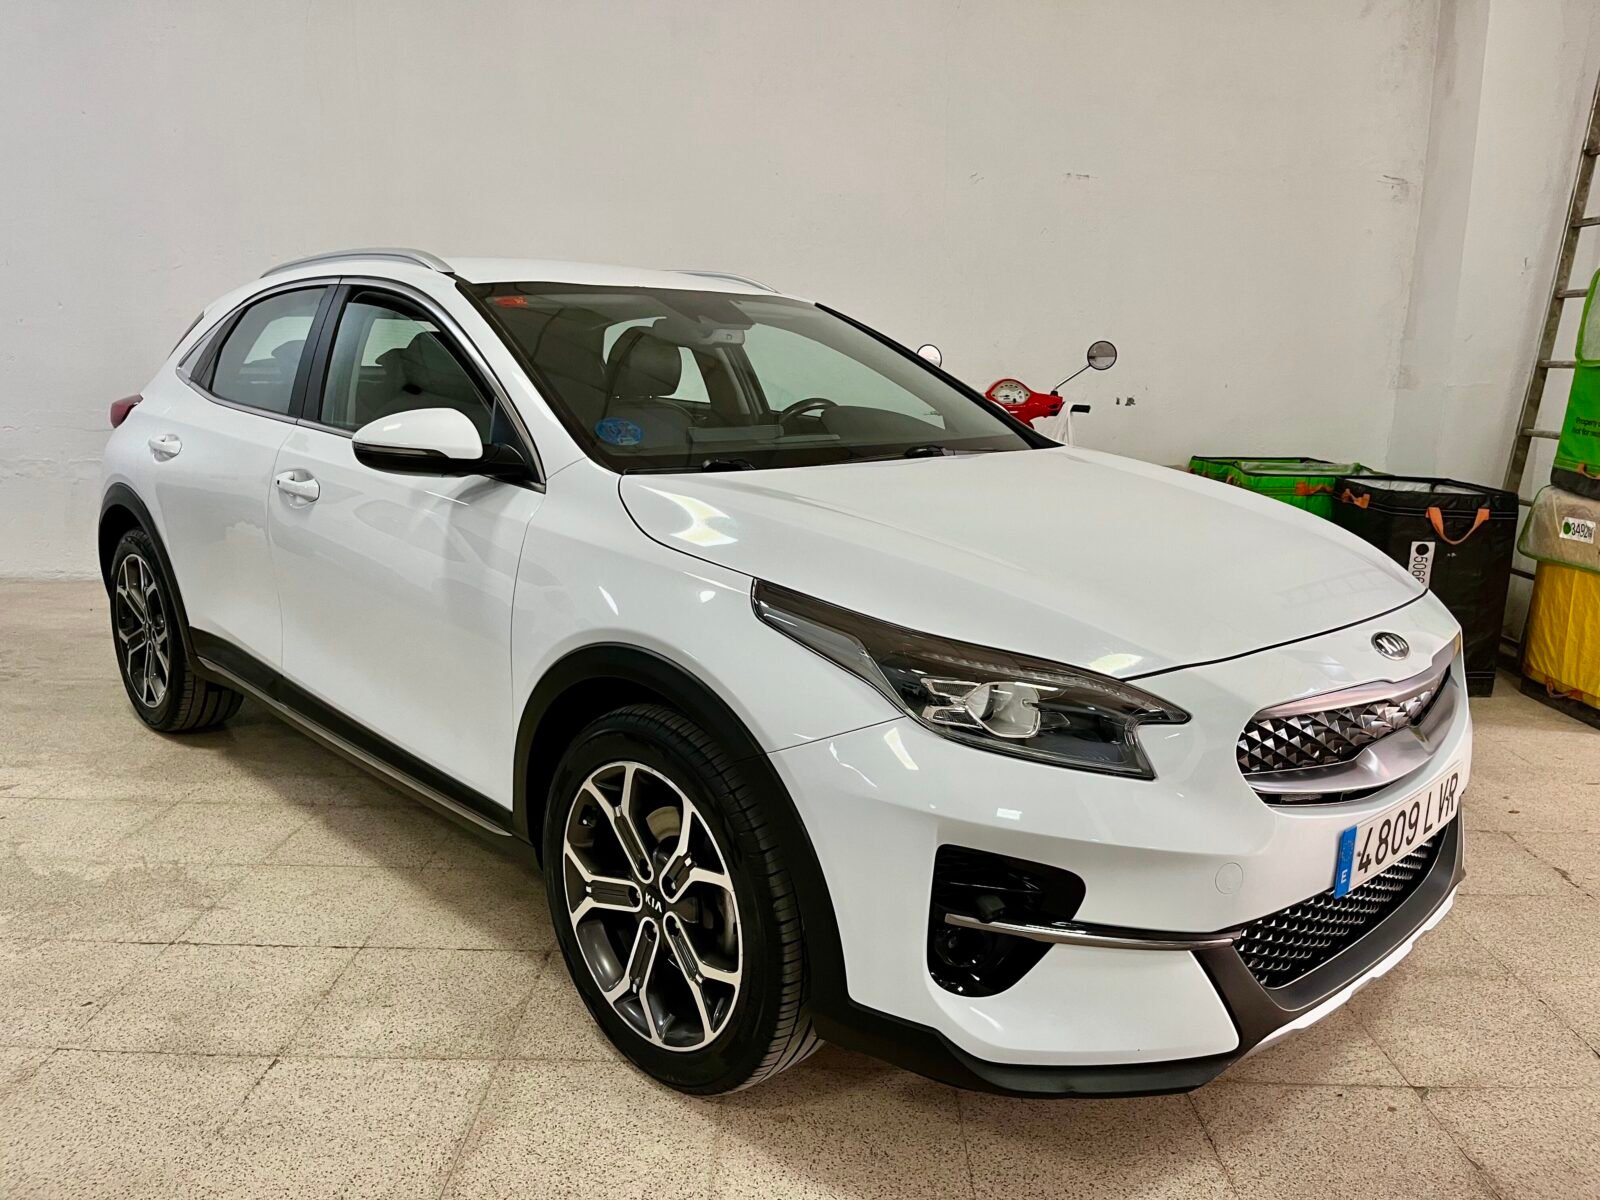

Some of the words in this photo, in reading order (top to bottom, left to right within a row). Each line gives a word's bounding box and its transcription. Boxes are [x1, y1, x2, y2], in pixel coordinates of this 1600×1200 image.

[1340, 869, 1348, 884] E
[1357, 801, 1420, 874] 4809
[1423, 772, 1459, 835] LVR
[645, 892, 663, 913] KIA
